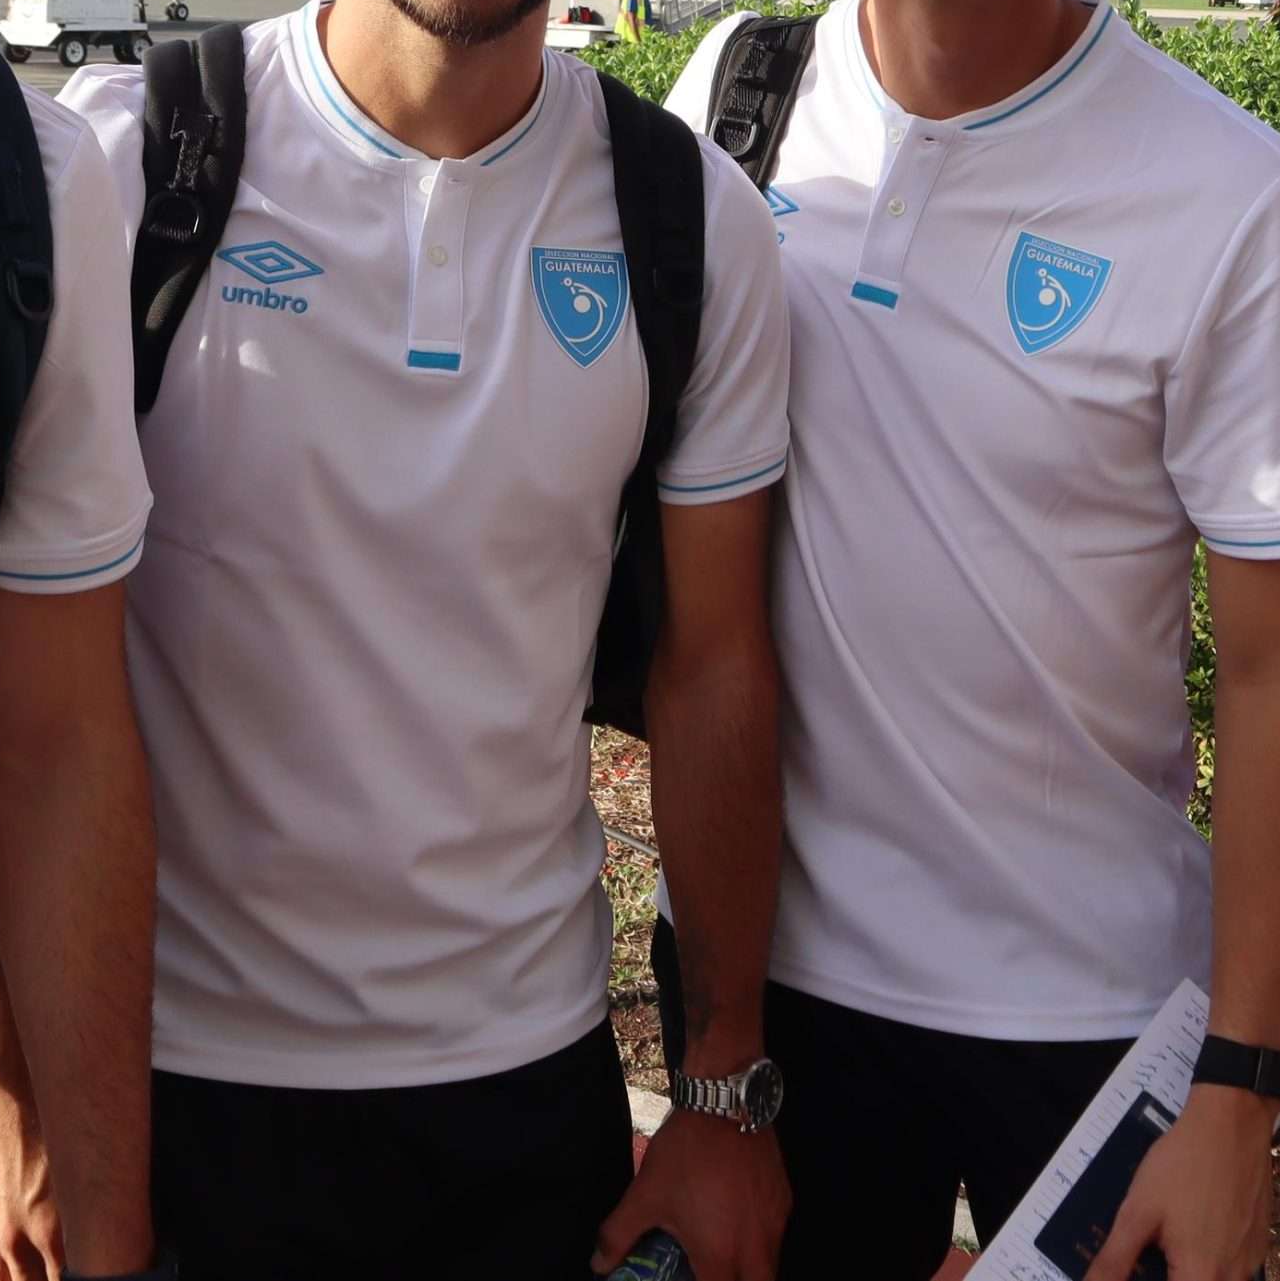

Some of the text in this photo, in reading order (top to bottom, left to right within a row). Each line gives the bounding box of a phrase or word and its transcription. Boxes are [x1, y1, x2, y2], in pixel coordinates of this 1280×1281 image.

[545, 261, 615, 275] GUATEMALA
[1026, 247, 1095, 278] GUATEMALA
[222, 286, 308, 314] umbro
